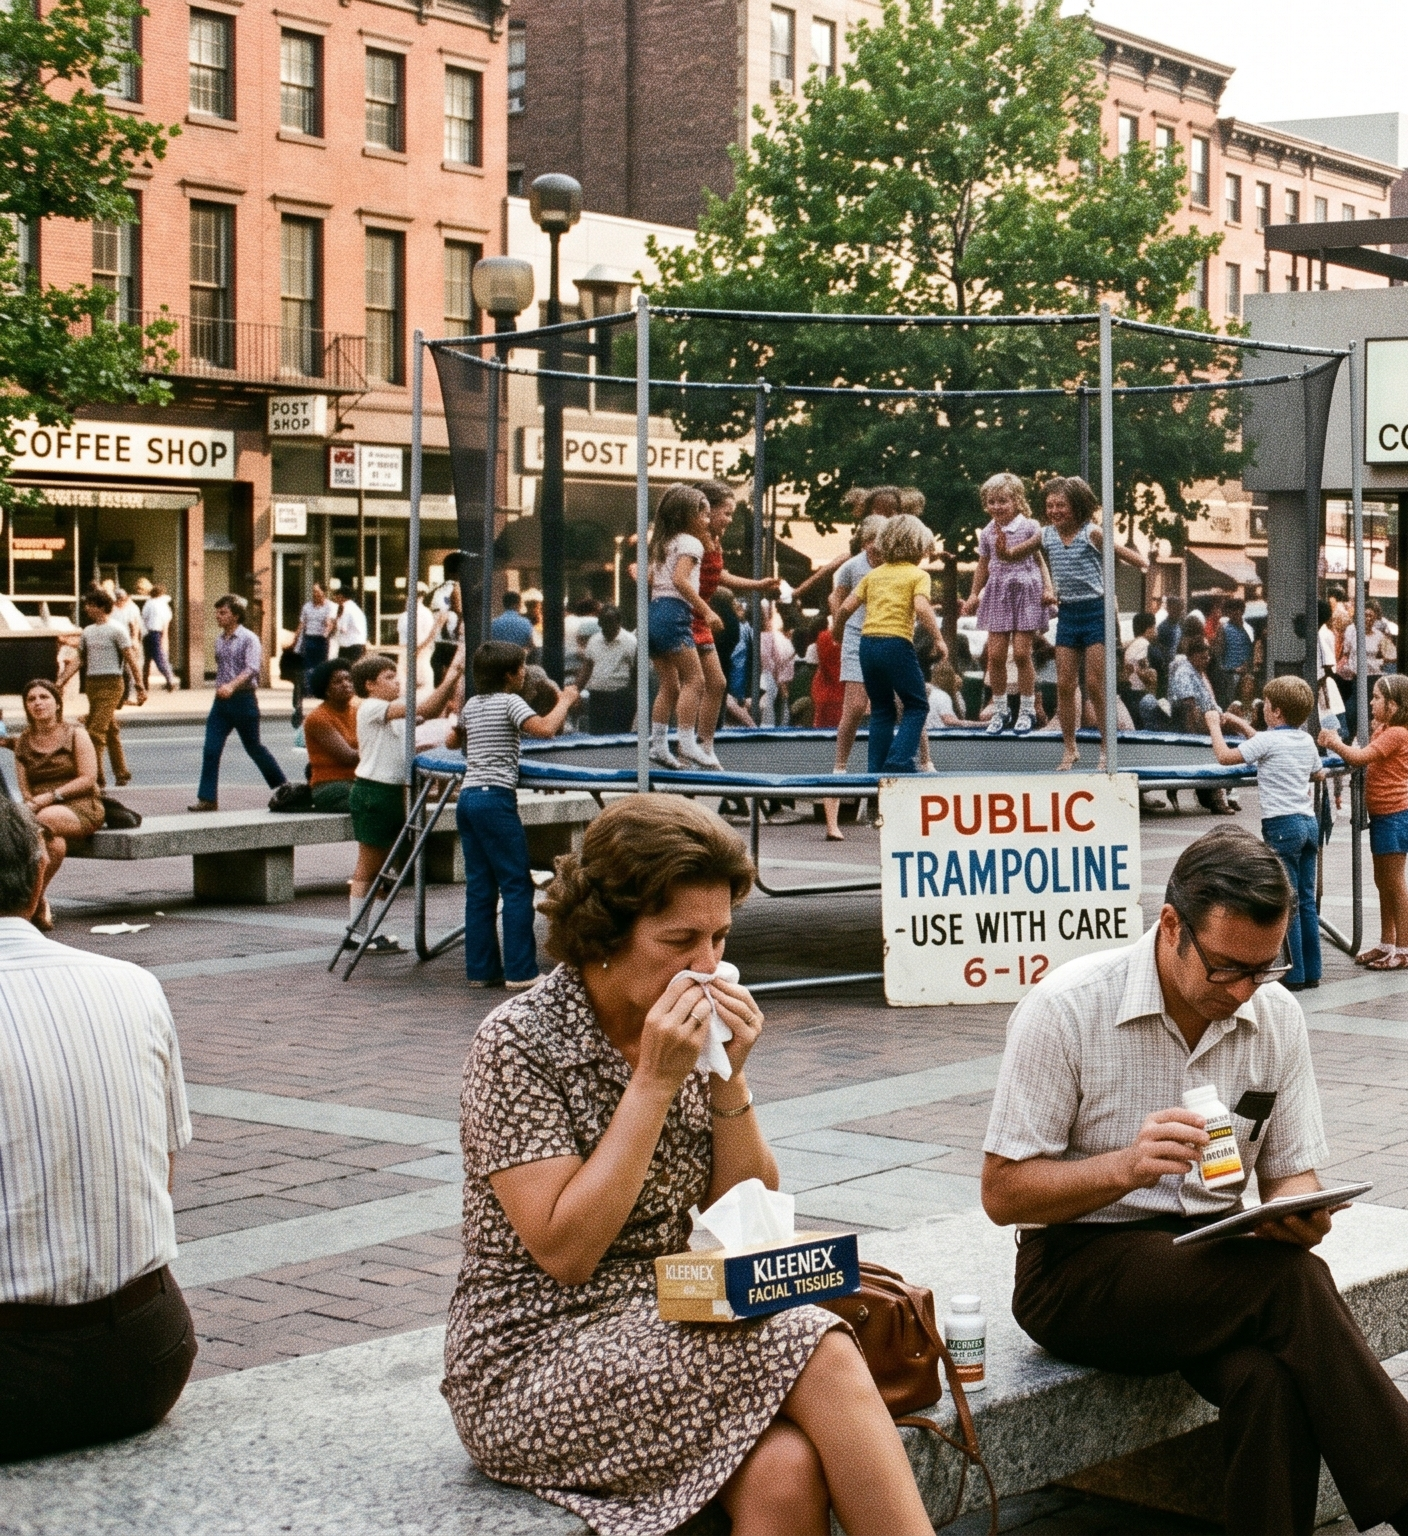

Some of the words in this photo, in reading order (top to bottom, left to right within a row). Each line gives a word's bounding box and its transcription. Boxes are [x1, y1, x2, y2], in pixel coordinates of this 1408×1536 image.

[271, 402, 309, 415] POST
[273, 418, 310, 431] SHOP
[9, 429, 131, 462] COFFEE
[147, 438, 227, 467] SHOP
[565, 438, 628, 466] POST
[920, 790, 1096, 837] PUBLIC
[891, 844, 1131, 898] TRAMPOLINE
[976, 910, 1047, 944] WITH
[1058, 907, 1129, 940] CARE
[665, 1264, 715, 1281] KLEENEX
[753, 1245, 836, 1285] KLEENEX
[748, 1282, 792, 1304] FACIAL
[794, 1270, 845, 1295] TISSUES
